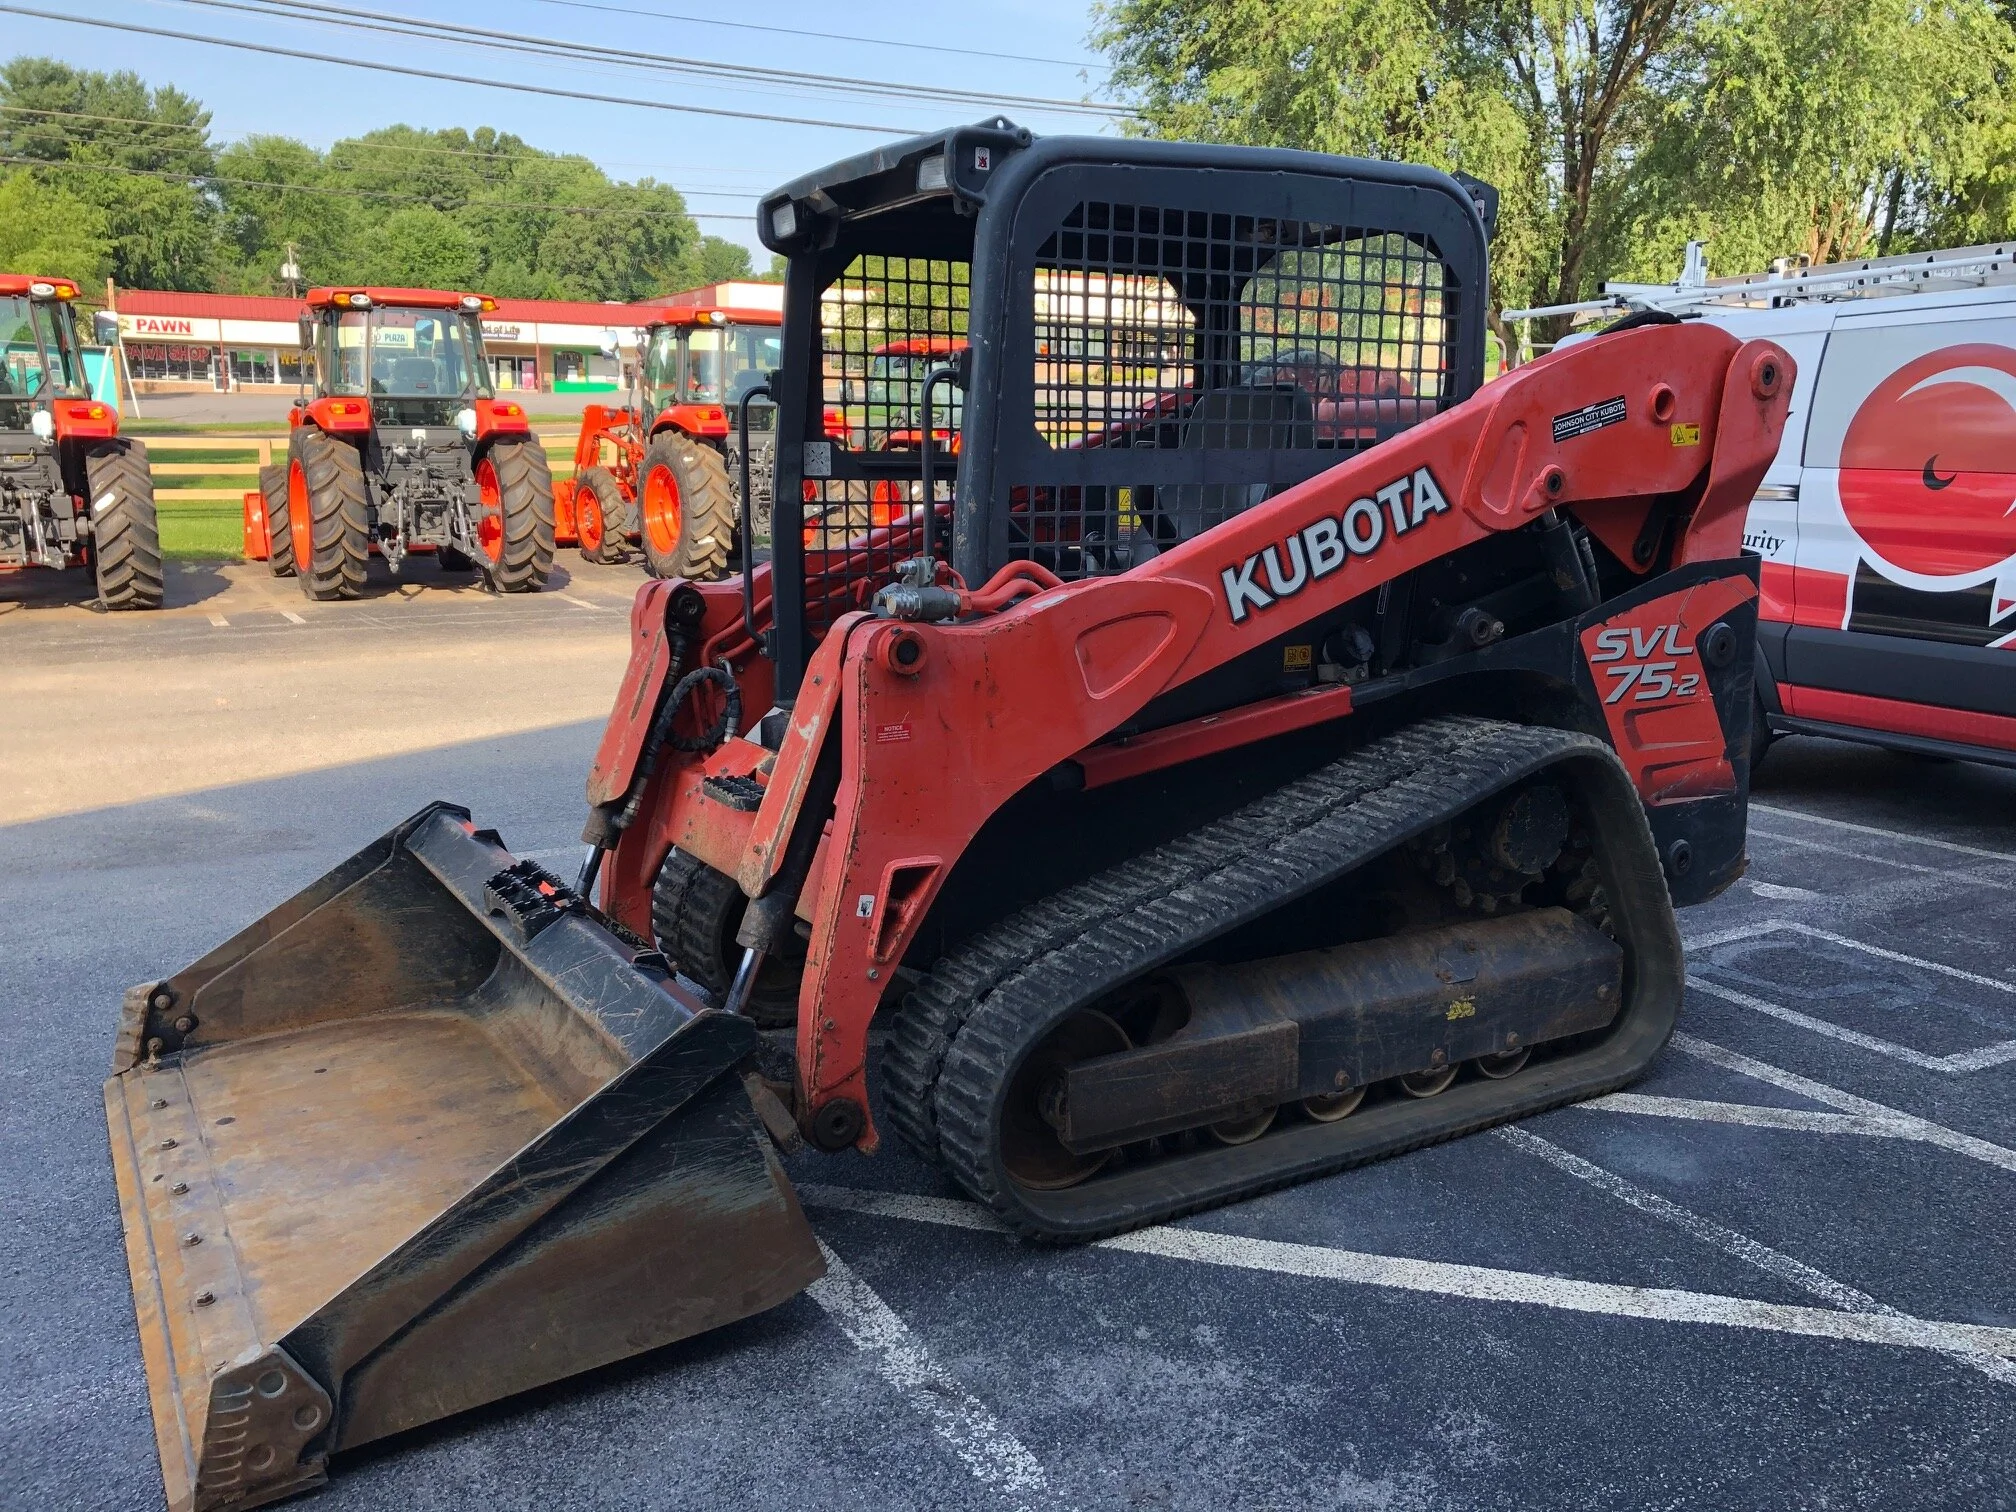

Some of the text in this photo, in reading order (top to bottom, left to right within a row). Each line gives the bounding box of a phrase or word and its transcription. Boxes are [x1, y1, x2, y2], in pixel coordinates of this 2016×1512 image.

[136, 318, 191, 333] PAWN
[384, 333, 406, 343] PLAZA
[125, 343, 209, 362] PAWN SHOP
[1554, 415, 1585, 432] JOHNSON
[1585, 411, 1600, 421] CITY
[1600, 402, 1626, 417] KUBOTA
[1221, 466, 1450, 622] KUBOTA
[1590, 624, 1694, 662] SVL
[1604, 661, 1700, 704] 75-2
